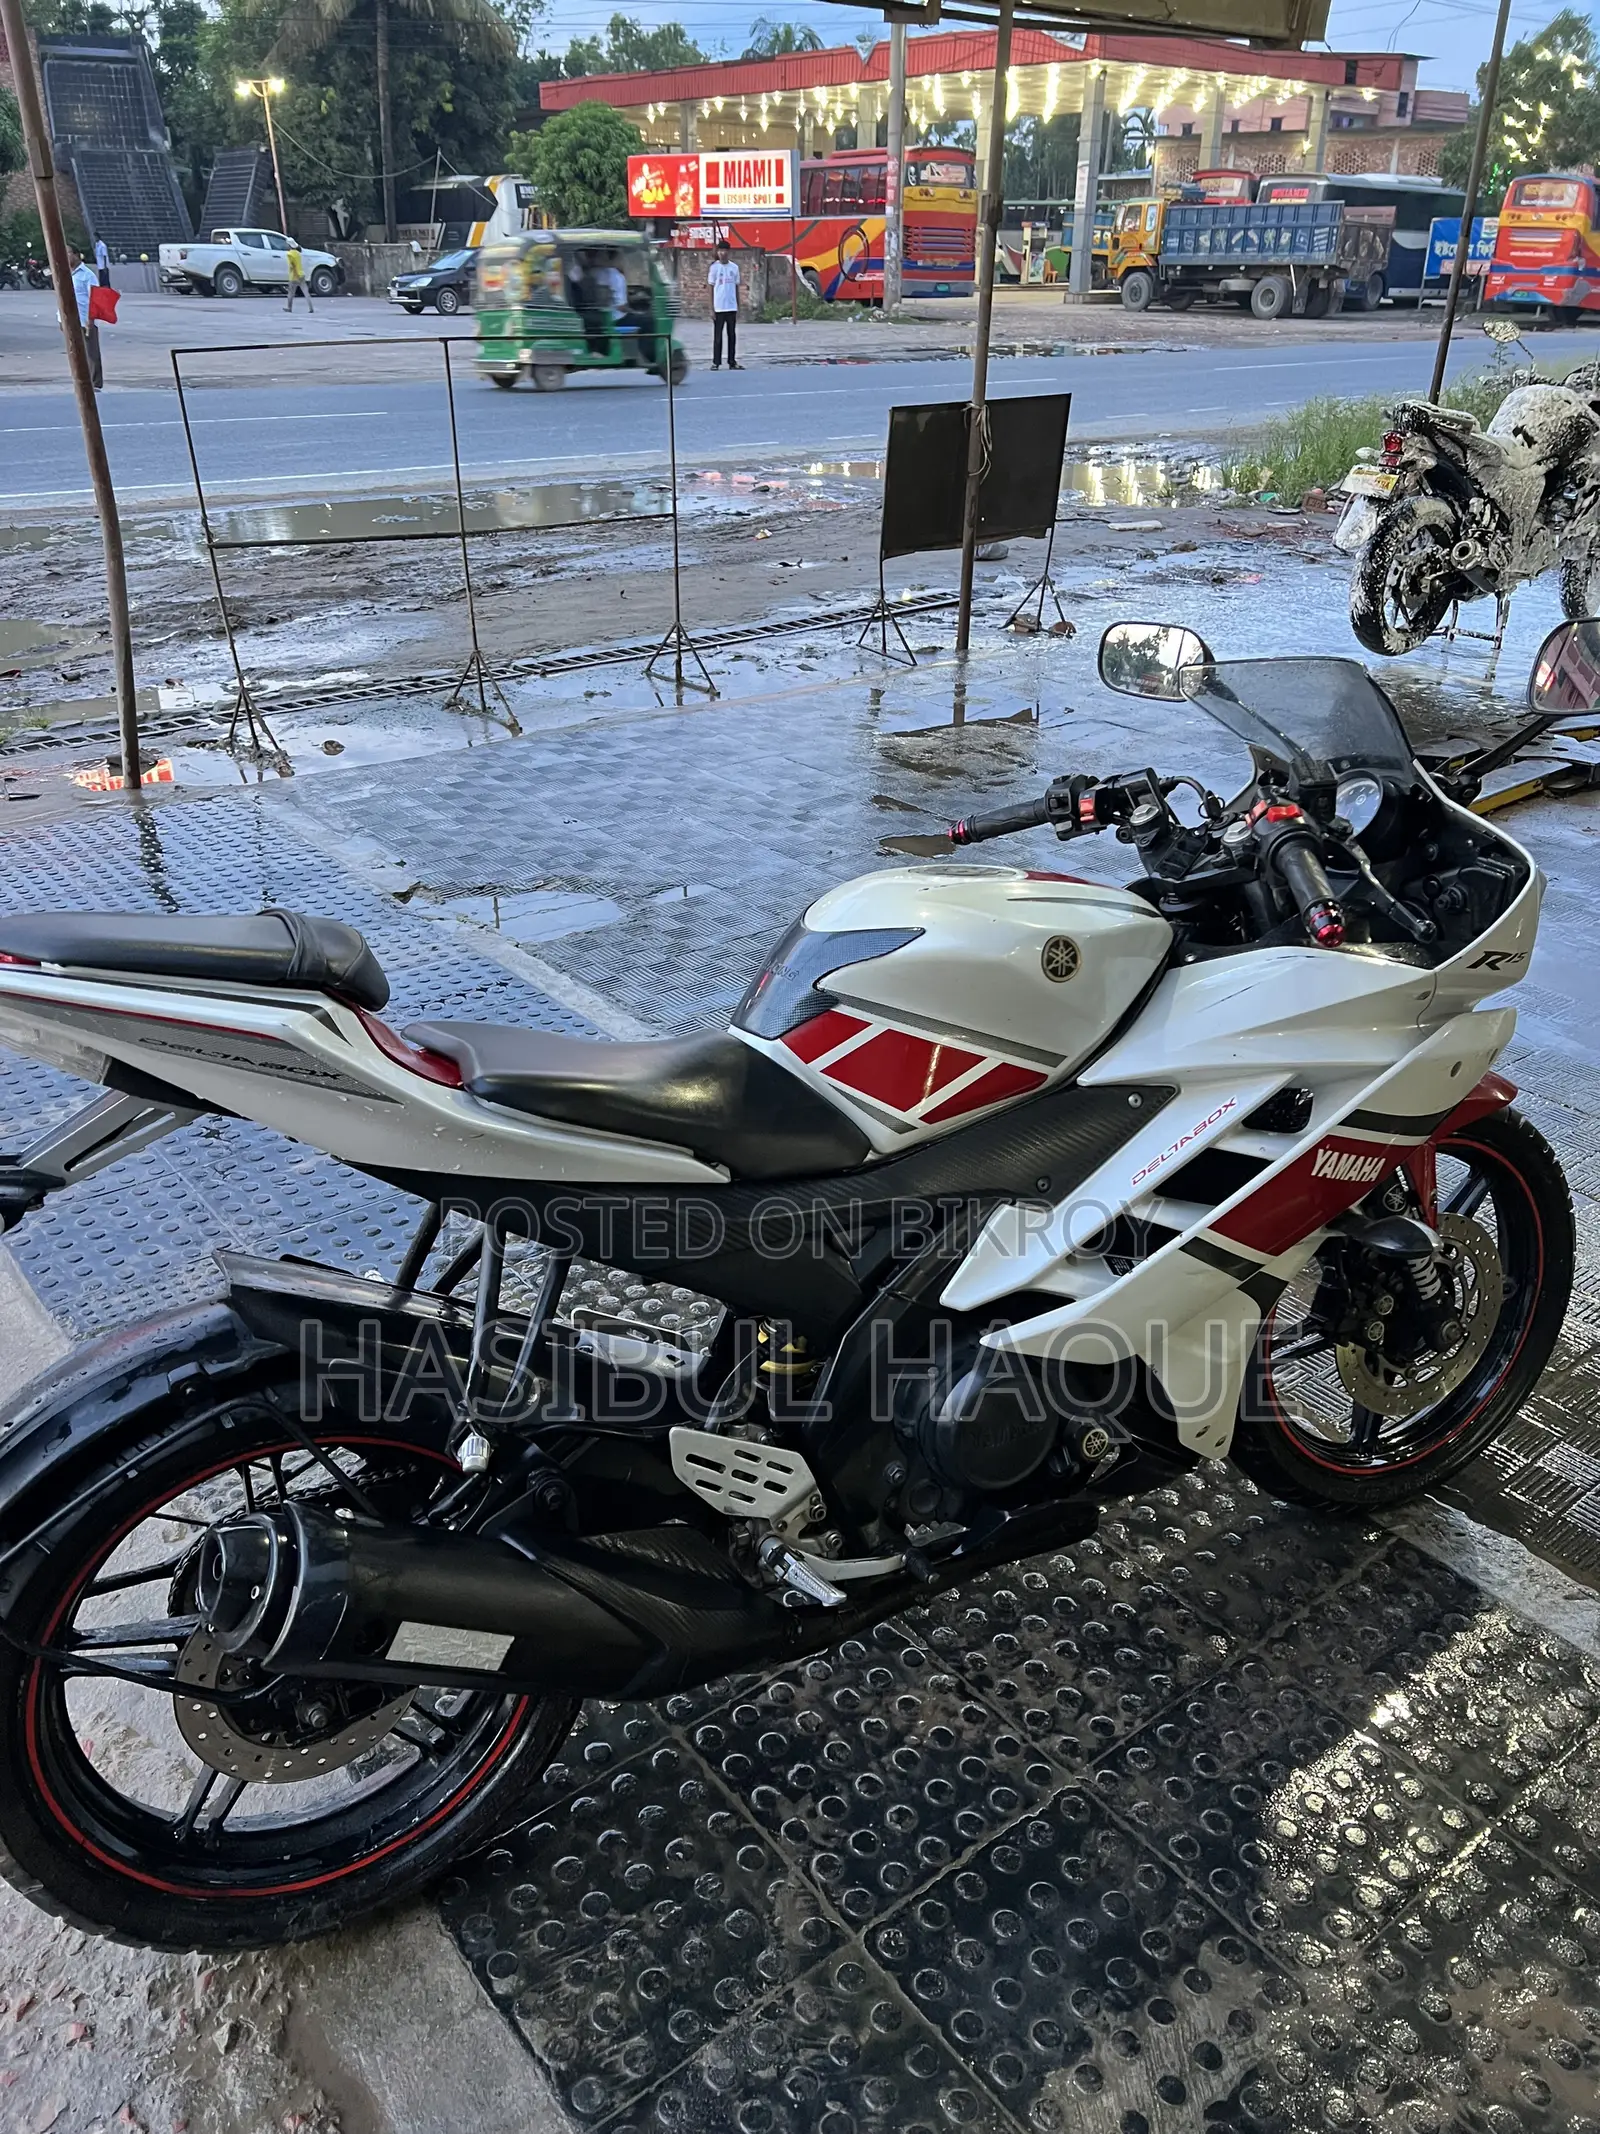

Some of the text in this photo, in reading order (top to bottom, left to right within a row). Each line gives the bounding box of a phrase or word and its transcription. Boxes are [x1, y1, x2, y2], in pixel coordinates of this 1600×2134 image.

[724, 160, 772, 188] MIAMI
[753, 193, 772, 204] SPOT
[1466, 951, 1528, 971] R15
[138, 1037, 342, 1080] DELTABOX
[1131, 1097, 1237, 1185] DELTABOX
[1311, 1149, 1386, 1183] YAMAHA
